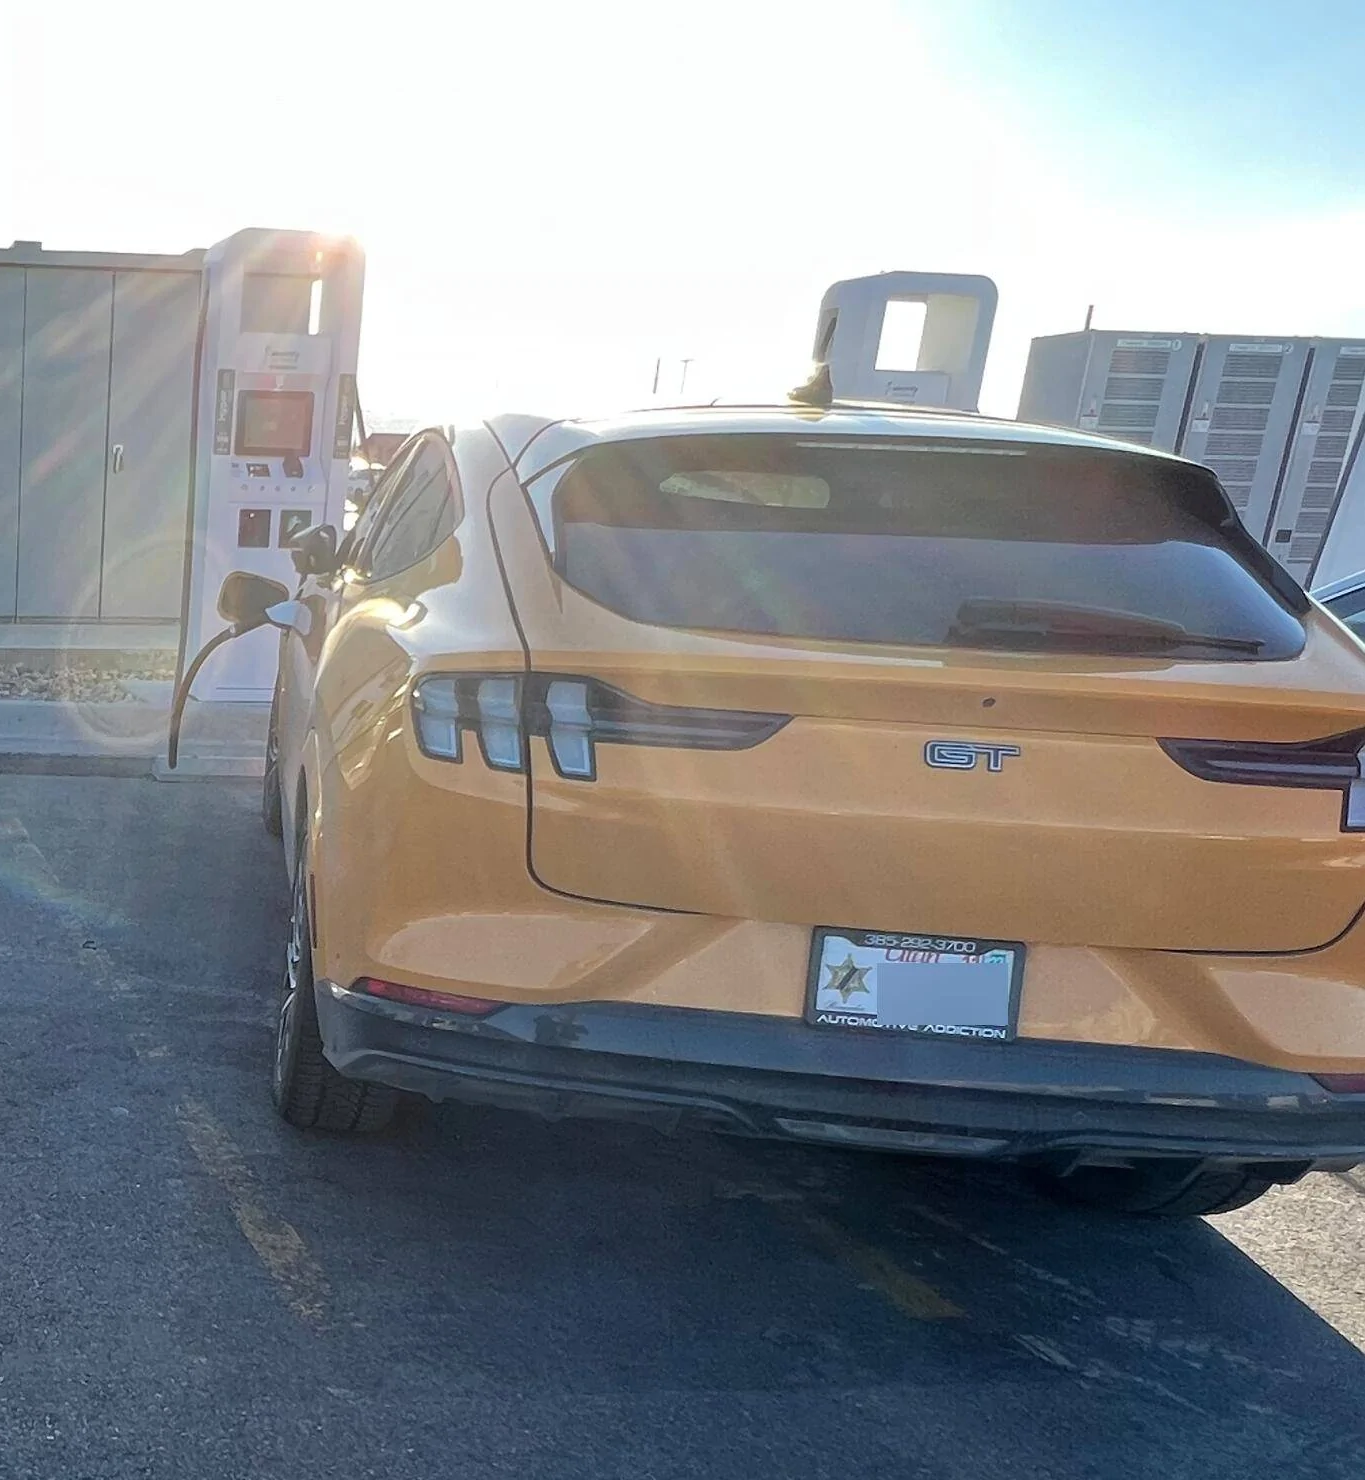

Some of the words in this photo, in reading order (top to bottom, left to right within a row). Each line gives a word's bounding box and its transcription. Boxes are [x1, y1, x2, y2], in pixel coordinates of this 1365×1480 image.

[924, 740, 1021, 772] GT
[864, 934, 976, 953] 385-292-3700
[923, 1024, 1006, 1039] ADDICTION
